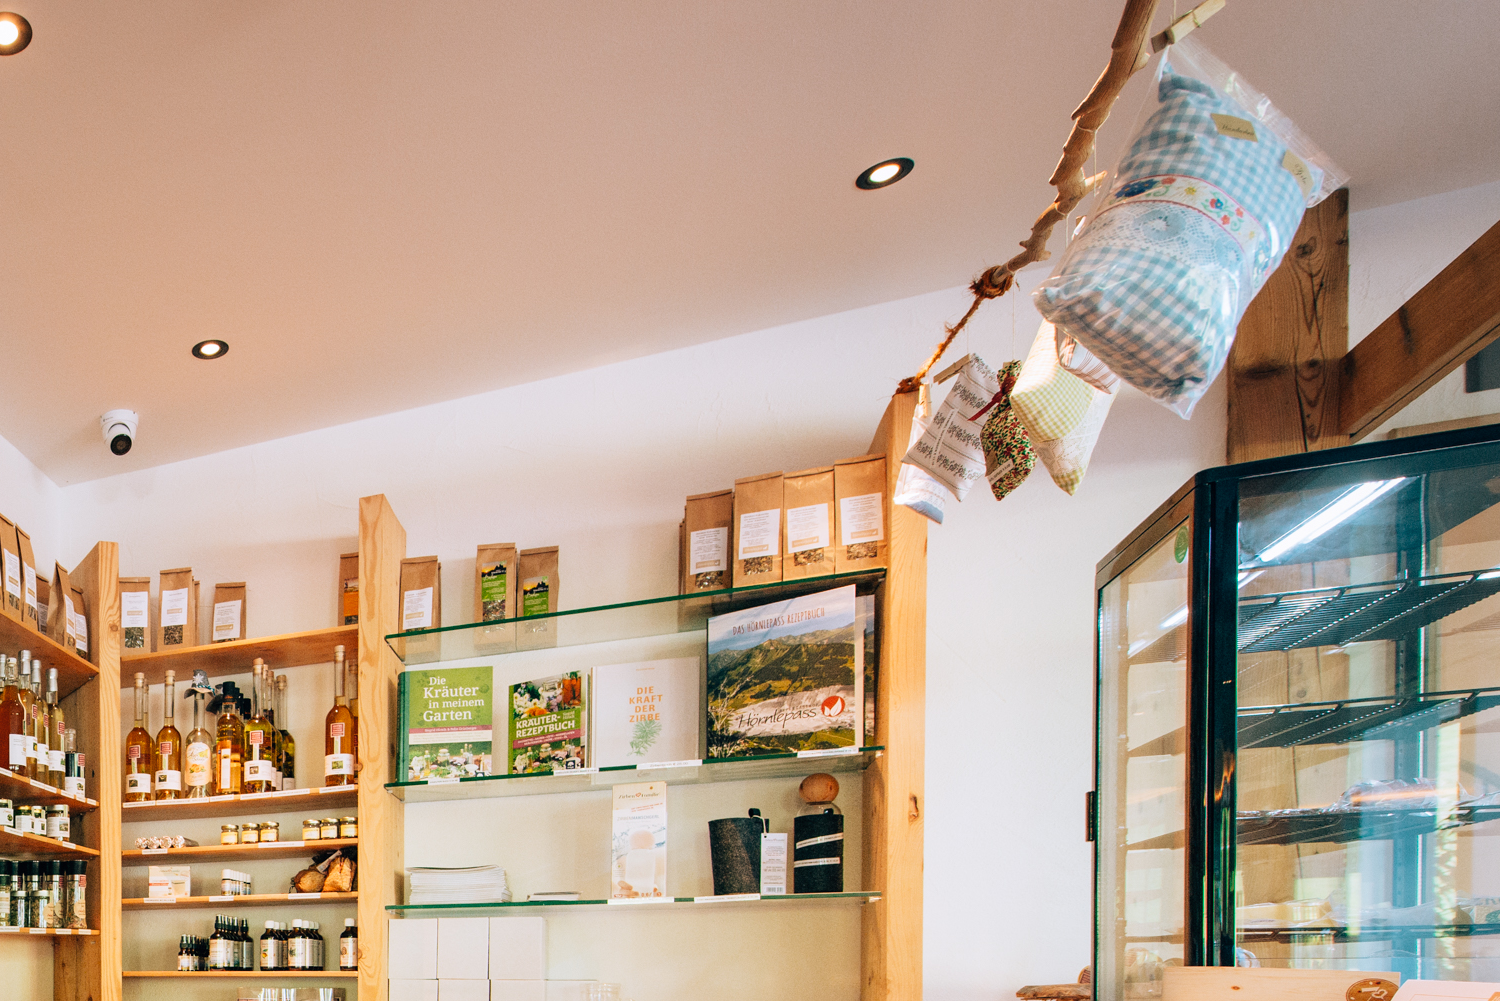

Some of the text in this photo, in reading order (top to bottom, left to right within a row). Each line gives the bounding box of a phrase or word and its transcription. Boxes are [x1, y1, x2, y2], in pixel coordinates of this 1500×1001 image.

[732, 607, 826, 636] DAS HÖRNLEPASS REZEPTBUCH
[429, 676, 447, 686] Die
[423, 685, 479, 699] Kräuter
[636, 685, 655, 695] DIE
[428, 698, 485, 709] in meinem
[628, 694, 664, 705] KRAFT
[634, 704, 656, 713] DER
[423, 710, 473, 722] Garten
[515, 714, 561, 729] KRÄUTER-
[629, 712, 661, 723] ZIRBE
[736, 706, 818, 730] Hörnlepass
[515, 719, 576, 738] REZEPTBUCH
